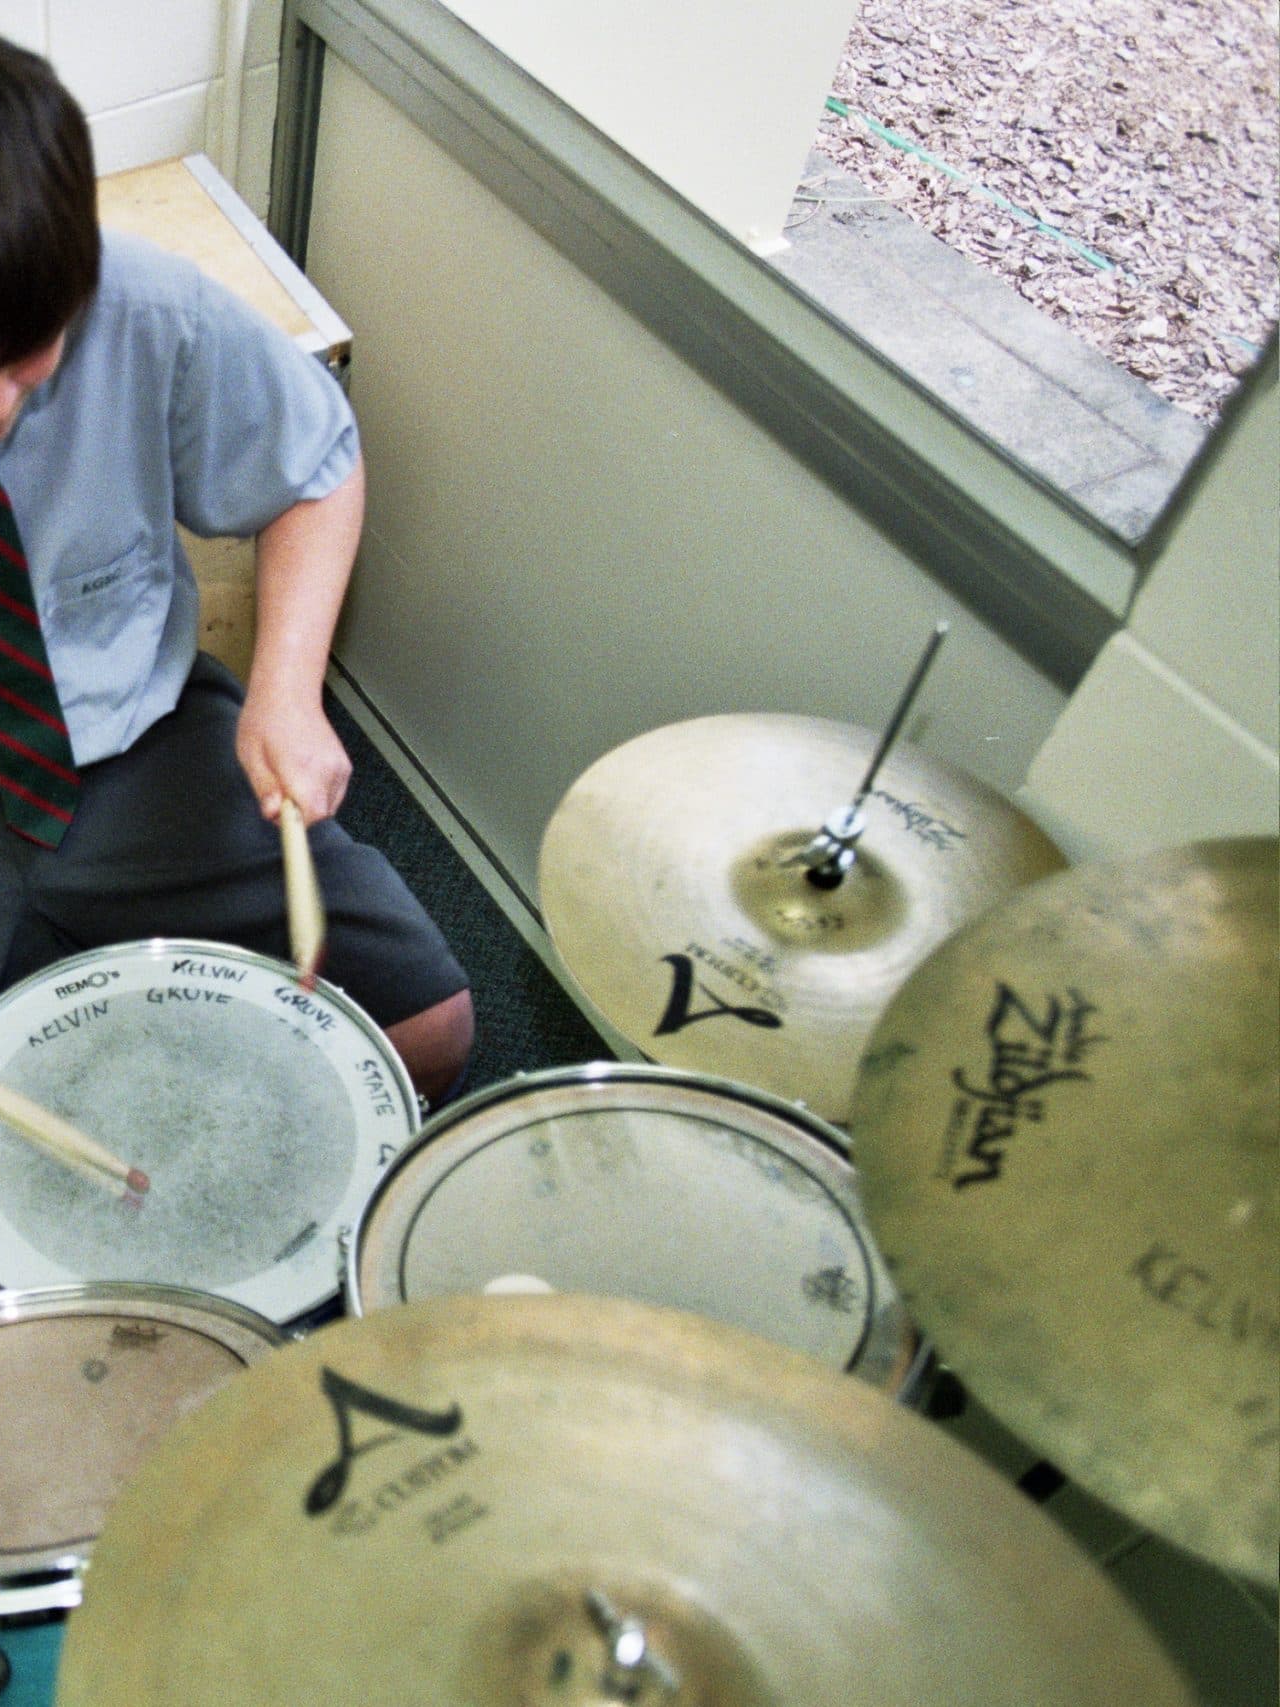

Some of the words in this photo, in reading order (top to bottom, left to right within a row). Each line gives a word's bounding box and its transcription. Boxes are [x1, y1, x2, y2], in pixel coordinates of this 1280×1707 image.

[28, 999, 109, 1048] KELVIN
[171, 958, 248, 982] KELVIN
[273, 986, 337, 1032] GROVE
[361, 1058, 397, 1117] STATE
[953, 981, 1092, 1192] Zildjian
